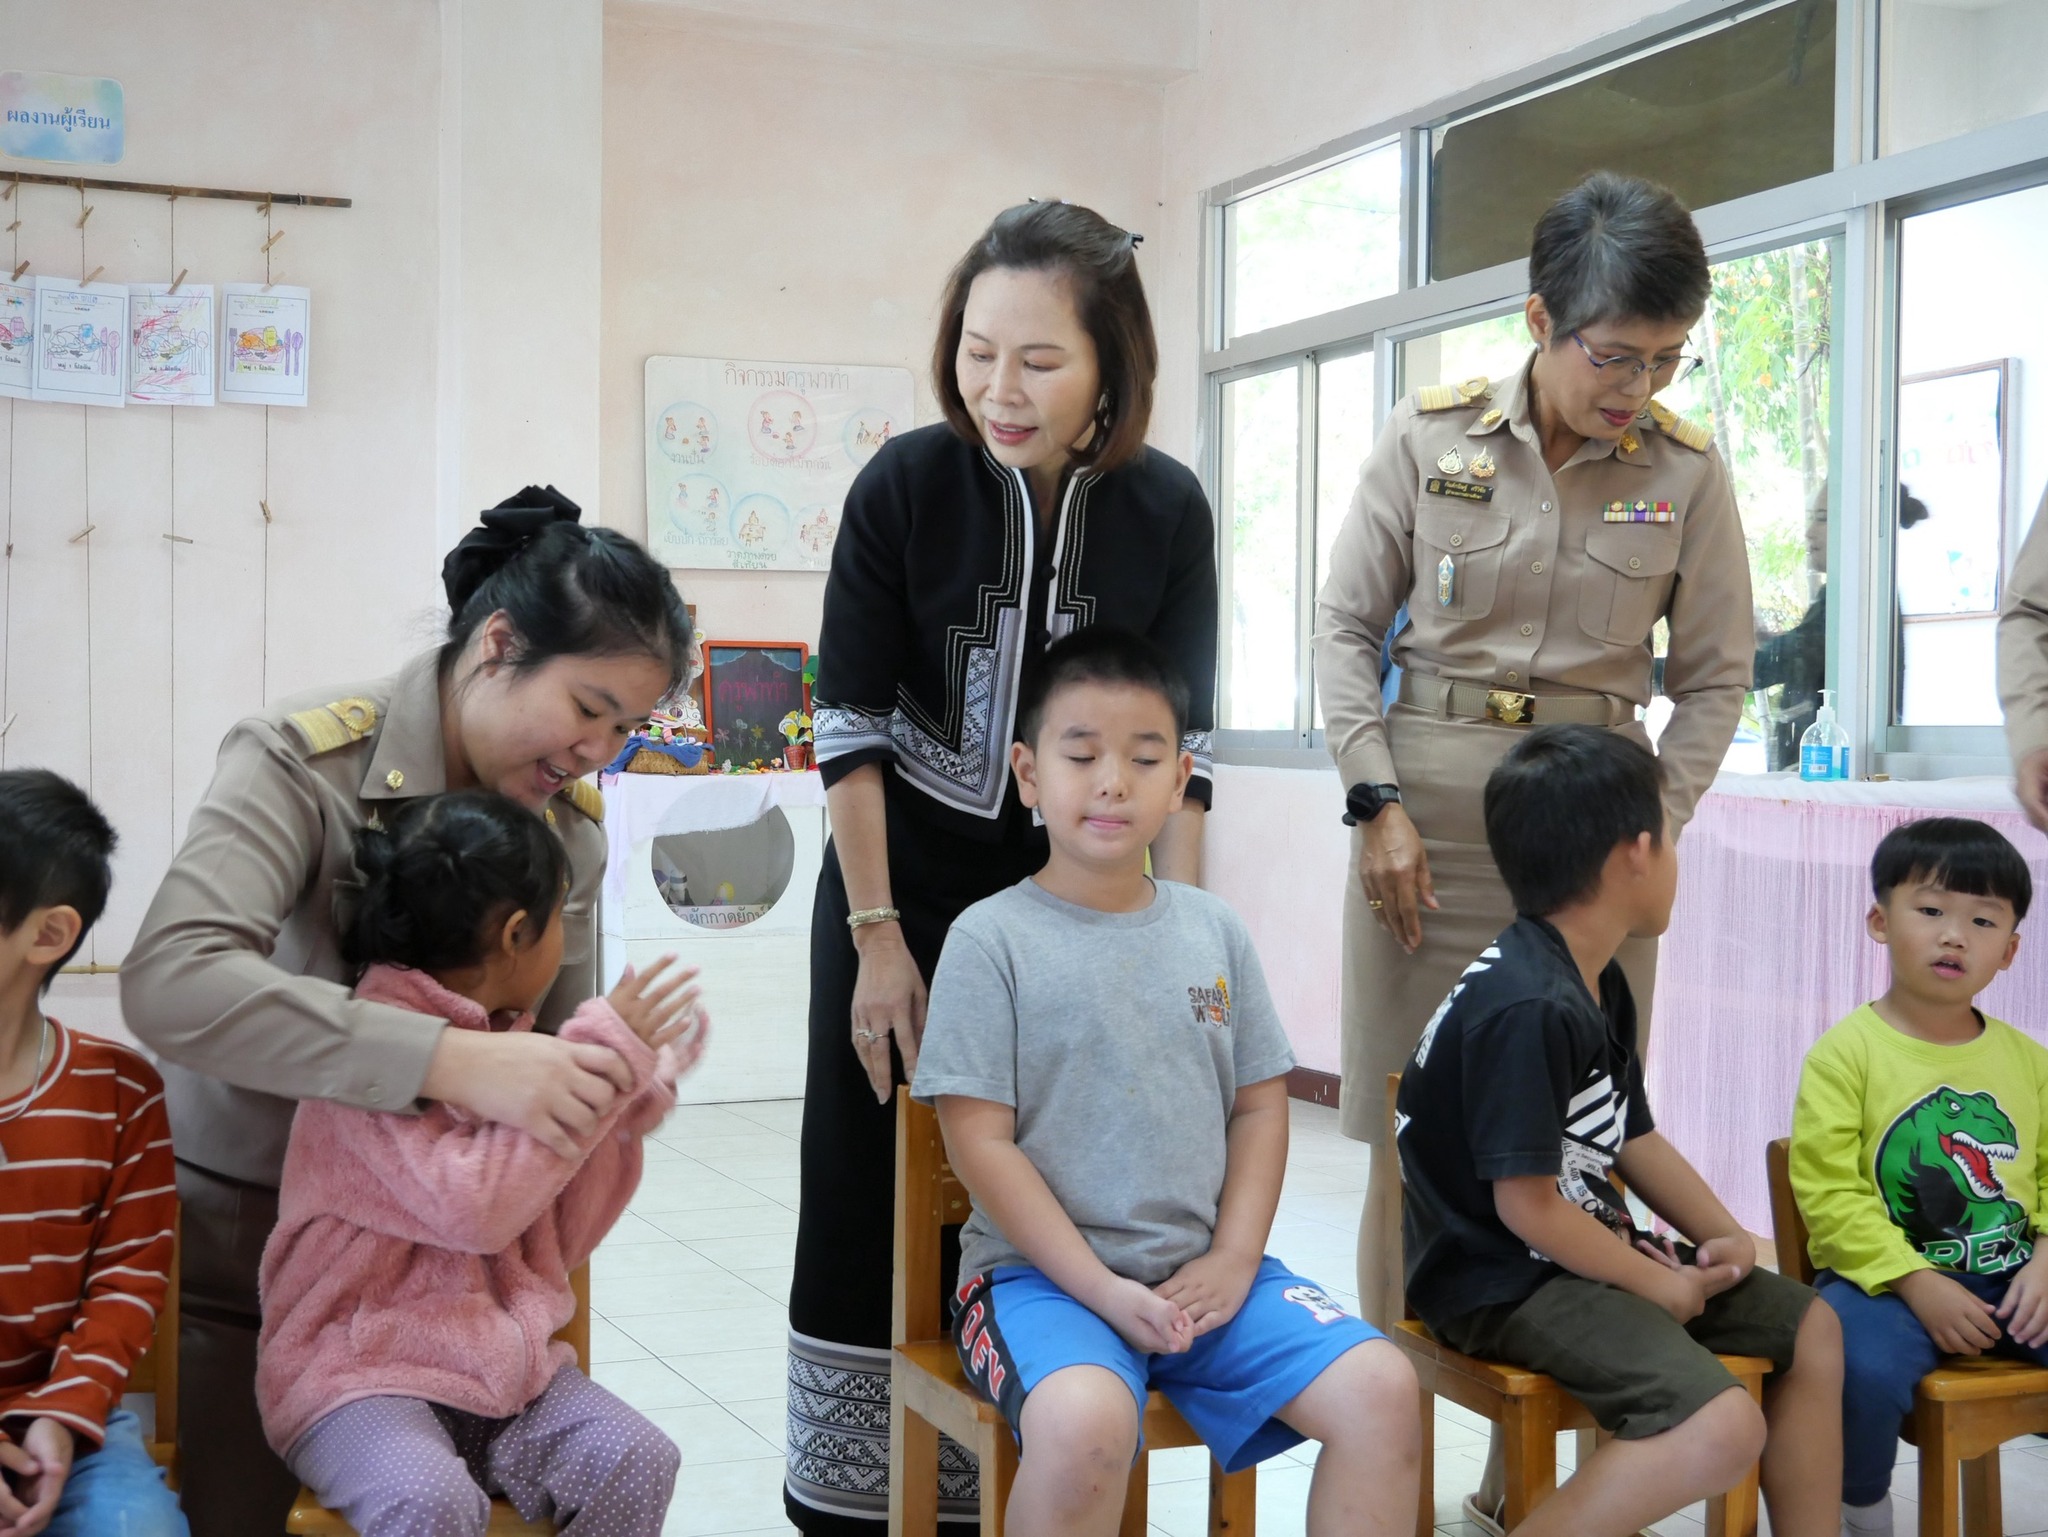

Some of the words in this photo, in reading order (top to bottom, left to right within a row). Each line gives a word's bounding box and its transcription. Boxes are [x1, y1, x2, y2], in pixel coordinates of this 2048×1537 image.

[7, 106, 110, 132] ผลงานผู้เรียน
[725, 361, 849, 395] กิจกรรมครูพาทำ
